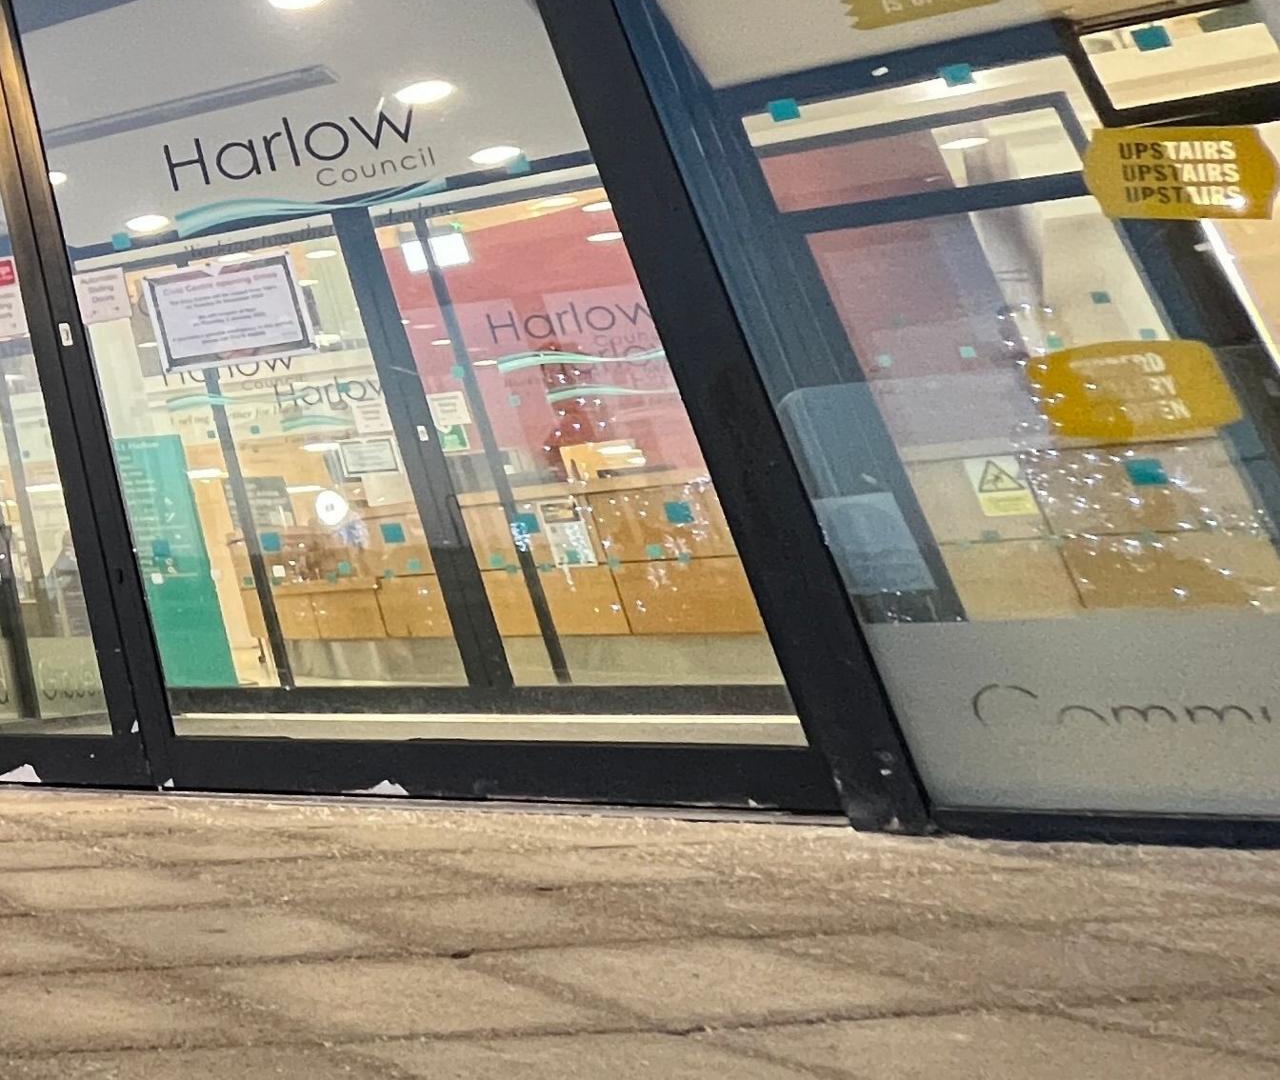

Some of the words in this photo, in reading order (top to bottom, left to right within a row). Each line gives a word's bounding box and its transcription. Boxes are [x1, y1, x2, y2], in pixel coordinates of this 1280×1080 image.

[163, 106, 414, 191] Harlow
[1119, 141, 1237, 160] UPSTAIRS
[316, 146, 436, 187] Council
[1122, 164, 1240, 182] UPSTAIRS
[1125, 186, 1246, 206] UPSTAIRS
